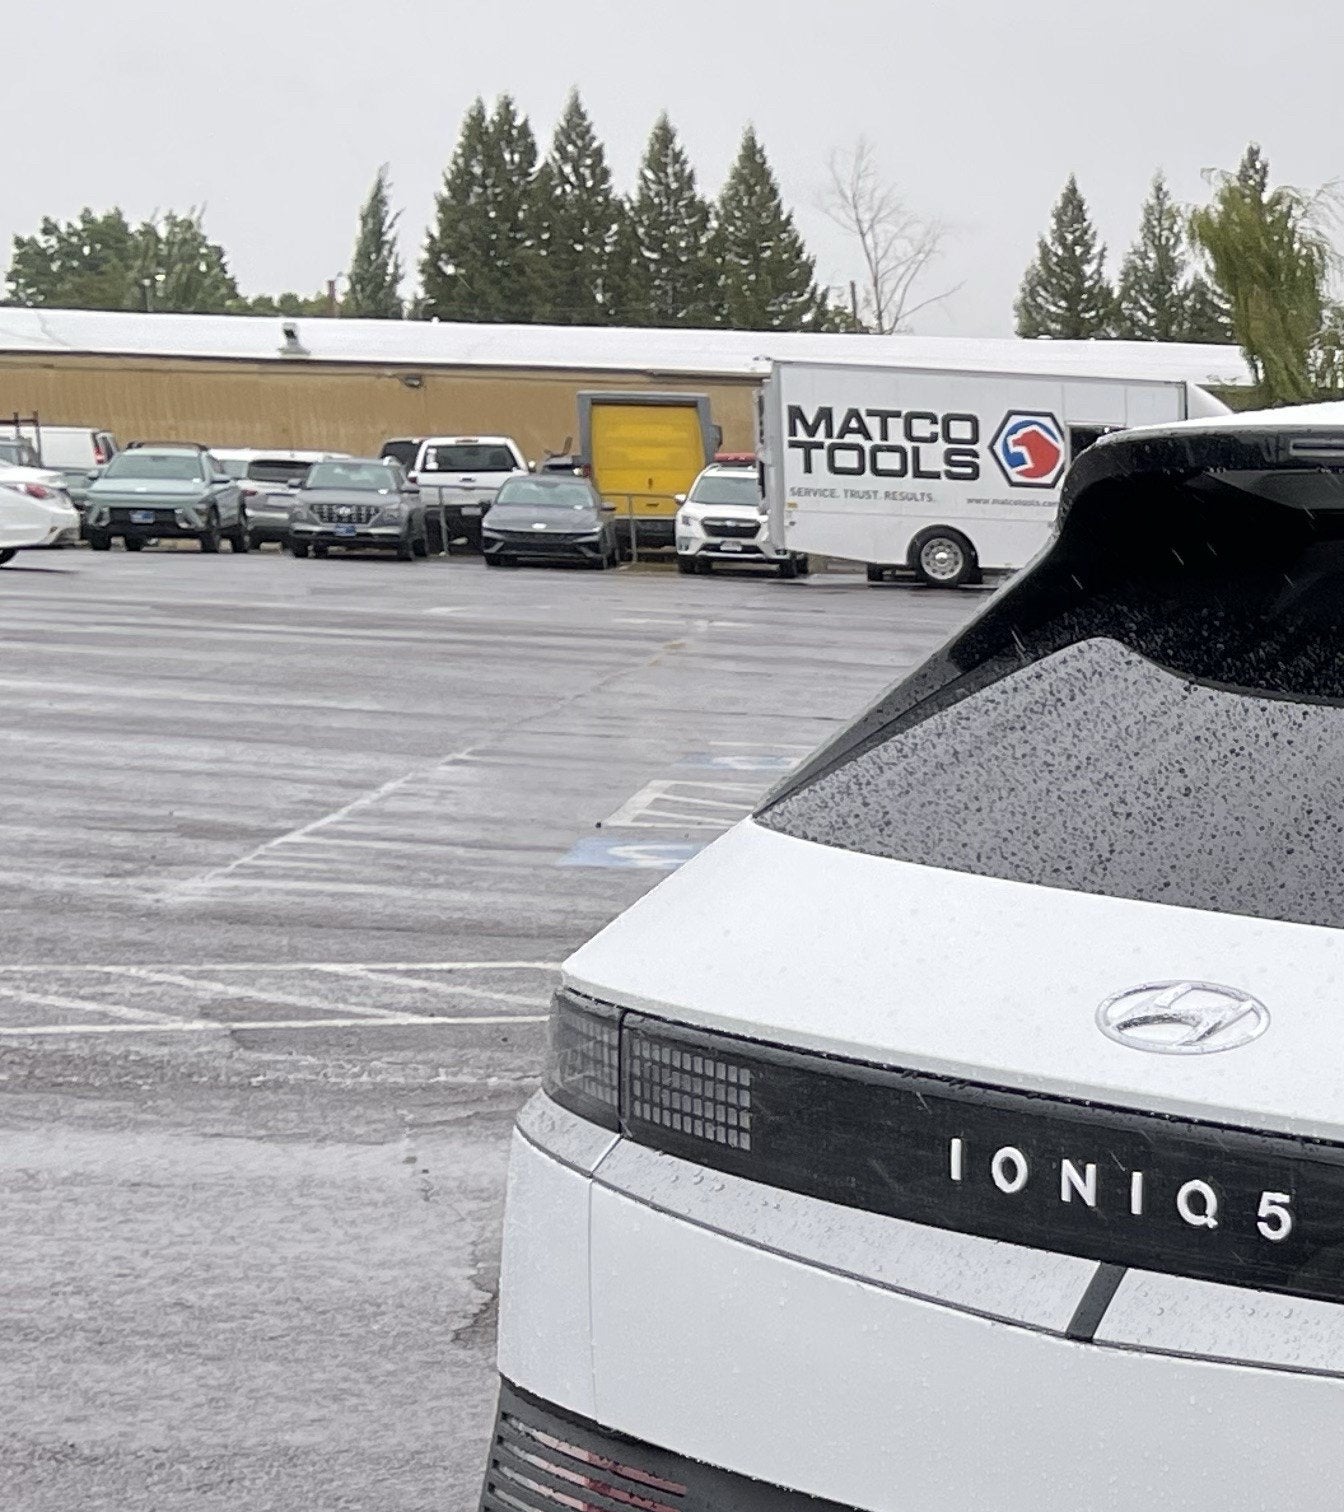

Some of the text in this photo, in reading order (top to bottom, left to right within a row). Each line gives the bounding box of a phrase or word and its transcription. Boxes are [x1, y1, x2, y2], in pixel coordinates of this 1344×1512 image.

[787, 404, 979, 445] MATCO
[787, 439, 980, 481] TOOLS
[949, 1137, 1293, 1242] IONIQ 5
